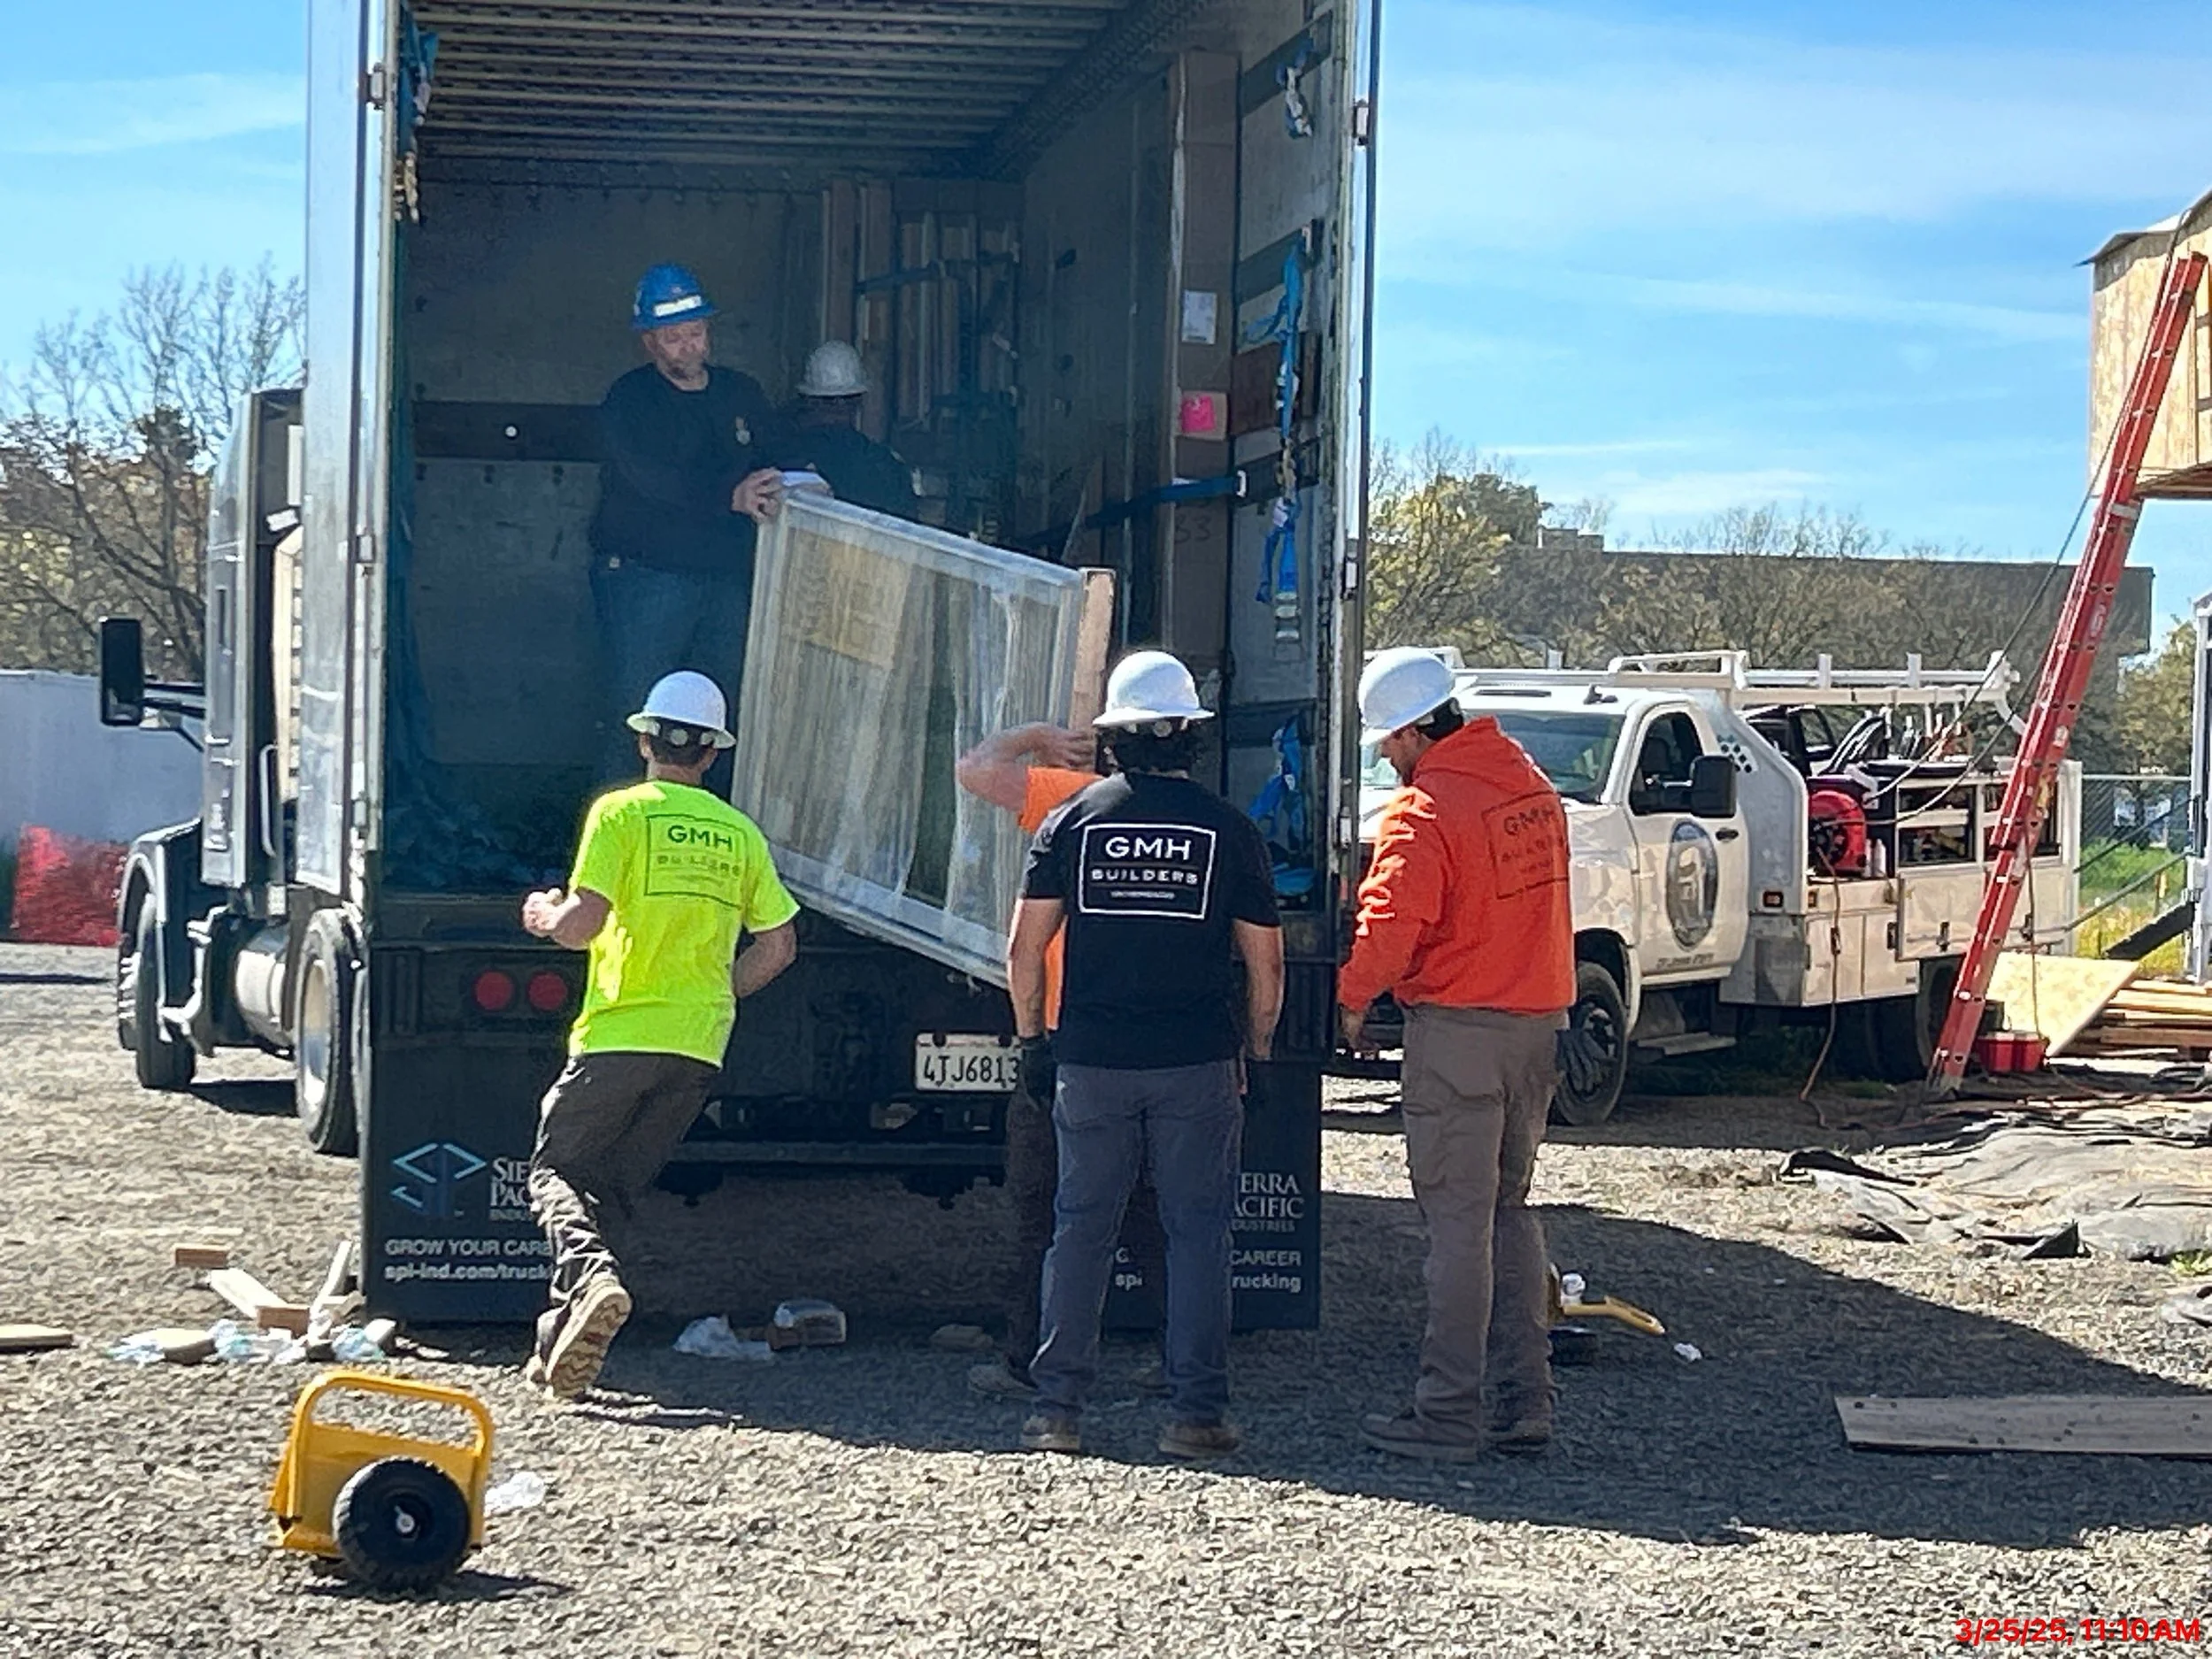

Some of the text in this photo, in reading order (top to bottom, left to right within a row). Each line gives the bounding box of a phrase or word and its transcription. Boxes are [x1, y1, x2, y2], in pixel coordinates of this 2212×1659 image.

[668, 825, 733, 852] GMH
[1105, 836, 1192, 861] GMH
[1091, 868, 1198, 885] BUILDERS
[492, 1156, 531, 1182] SIE
[1240, 1172, 1301, 1194] ERRA
[384, 1239, 552, 1256] GROW YOUR CARE
[1229, 1250, 1302, 1266] CAREER
[1232, 1272, 1302, 1293] rucking
